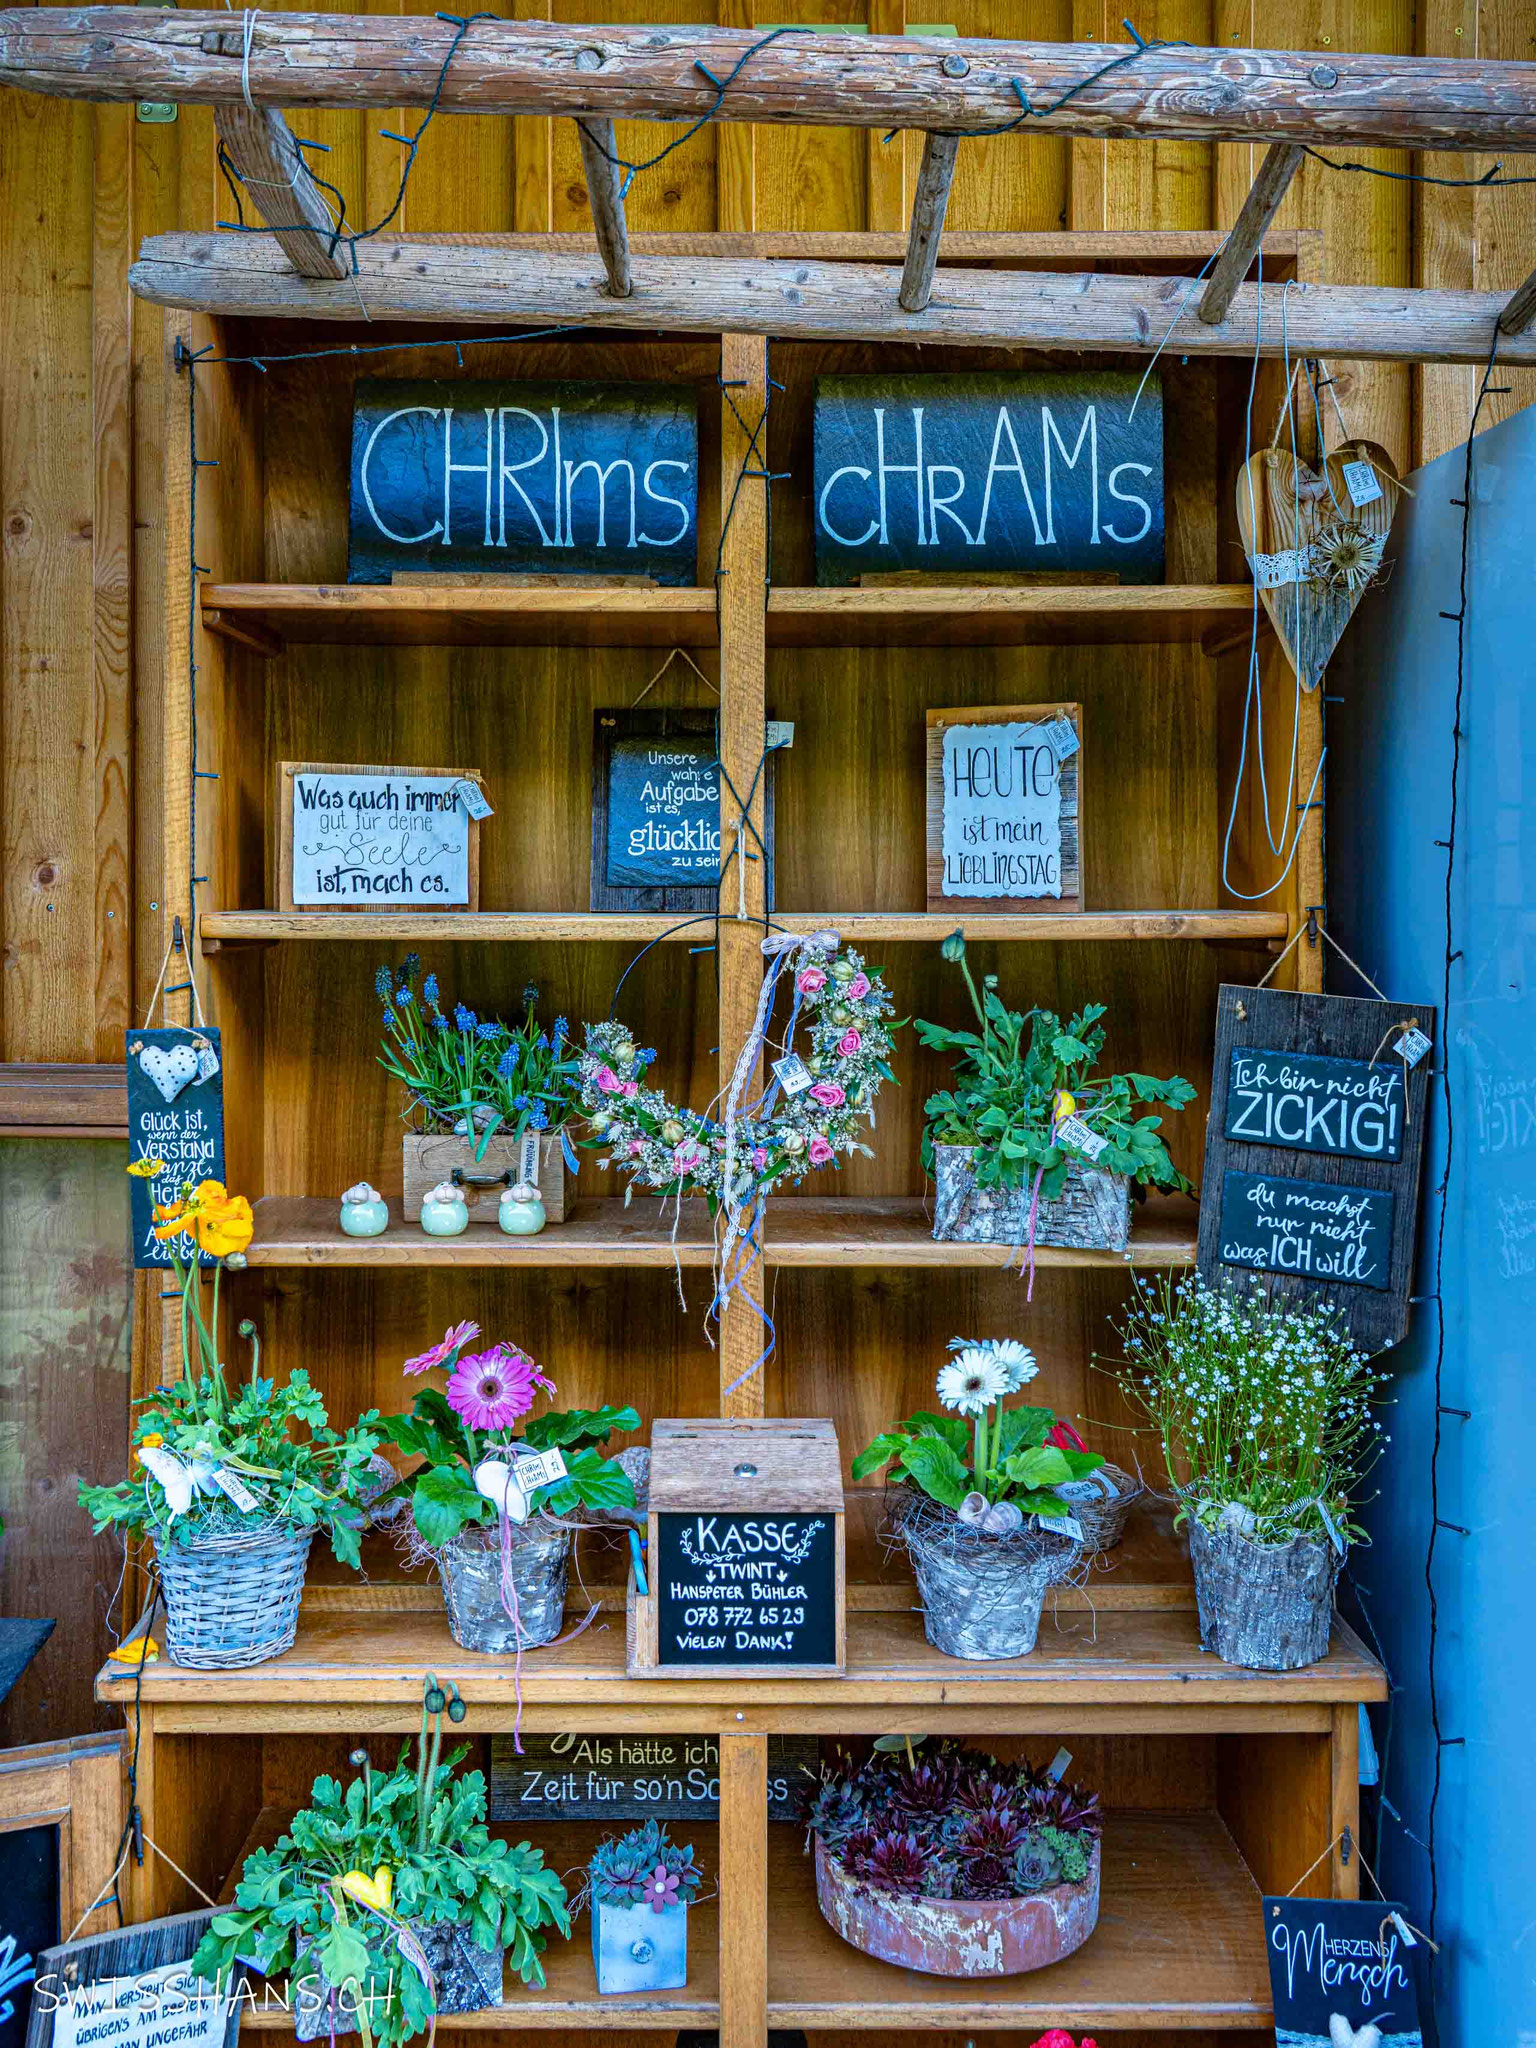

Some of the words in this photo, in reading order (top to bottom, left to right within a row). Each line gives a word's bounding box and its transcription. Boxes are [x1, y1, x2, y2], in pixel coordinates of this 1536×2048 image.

[648, 751, 698, 765] Unsere
[671, 767, 713, 781] wahe
[298, 778, 343, 809] Was
[348, 784, 399, 811] auch
[406, 785, 460, 813] immer
[640, 780, 719, 805] Aufgabe
[645, 803, 661, 814] ist
[664, 805, 681, 816] es,
[320, 811, 347, 834] gut
[356, 811, 381, 831] für
[388, 812, 433, 831] deine
[963, 815, 992, 845] ist
[996, 816, 1048, 845] mein
[340, 832, 438, 865] Seele
[628, 819, 720, 855] glücklic
[672, 856, 691, 867] zu
[317, 865, 350, 895] ist,
[352, 867, 412, 895] mach
[421, 876, 449, 894] es.
[1233, 1058, 1278, 1090] Ich
[1279, 1066, 1322, 1092] bin
[1327, 1074, 1402, 1109] nicht
[140, 1111, 181, 1131] Glück
[185, 1109, 208, 1131] ist,
[1231, 1089, 1396, 1155] ZICKIG!
[148, 1131, 177, 1140] wenn
[180, 1130, 201, 1139] der
[151, 1158, 213, 1182] anzt,
[161, 1174, 183, 1184] das
[1247, 1183, 1275, 1211] du
[1286, 1191, 1373, 1225] machst
[1257, 1213, 1304, 1238] nur
[1310, 1218, 1376, 1249] nicht
[1224, 1241, 1267, 1268] was
[1270, 1234, 1311, 1271] ICH
[1315, 1241, 1376, 1280] will
[698, 1517, 800, 1553] KASSE
[713, 1562, 777, 1580] TWINT
[671, 1582, 744, 1600] HANSPETER
[752, 1584, 808, 1600] BÜHLER
[684, 1606, 719, 1626] 078
[723, 1607, 754, 1626] 772
[760, 1607, 778, 1625] 65
[782, 1607, 805, 1625] 29
[735, 1631, 794, 1650] DANK!
[573, 1739, 612, 1765] Als
[620, 1739, 676, 1765] hätte
[685, 1739, 719, 1764] ich
[521, 1771, 579, 1801] Zeit
[586, 1771, 624, 1801] für
[1324, 1938, 1389, 1958] HERZENS
[1272, 1922, 1408, 2006] Mensch
[137, 2009, 157, 2027] AM
